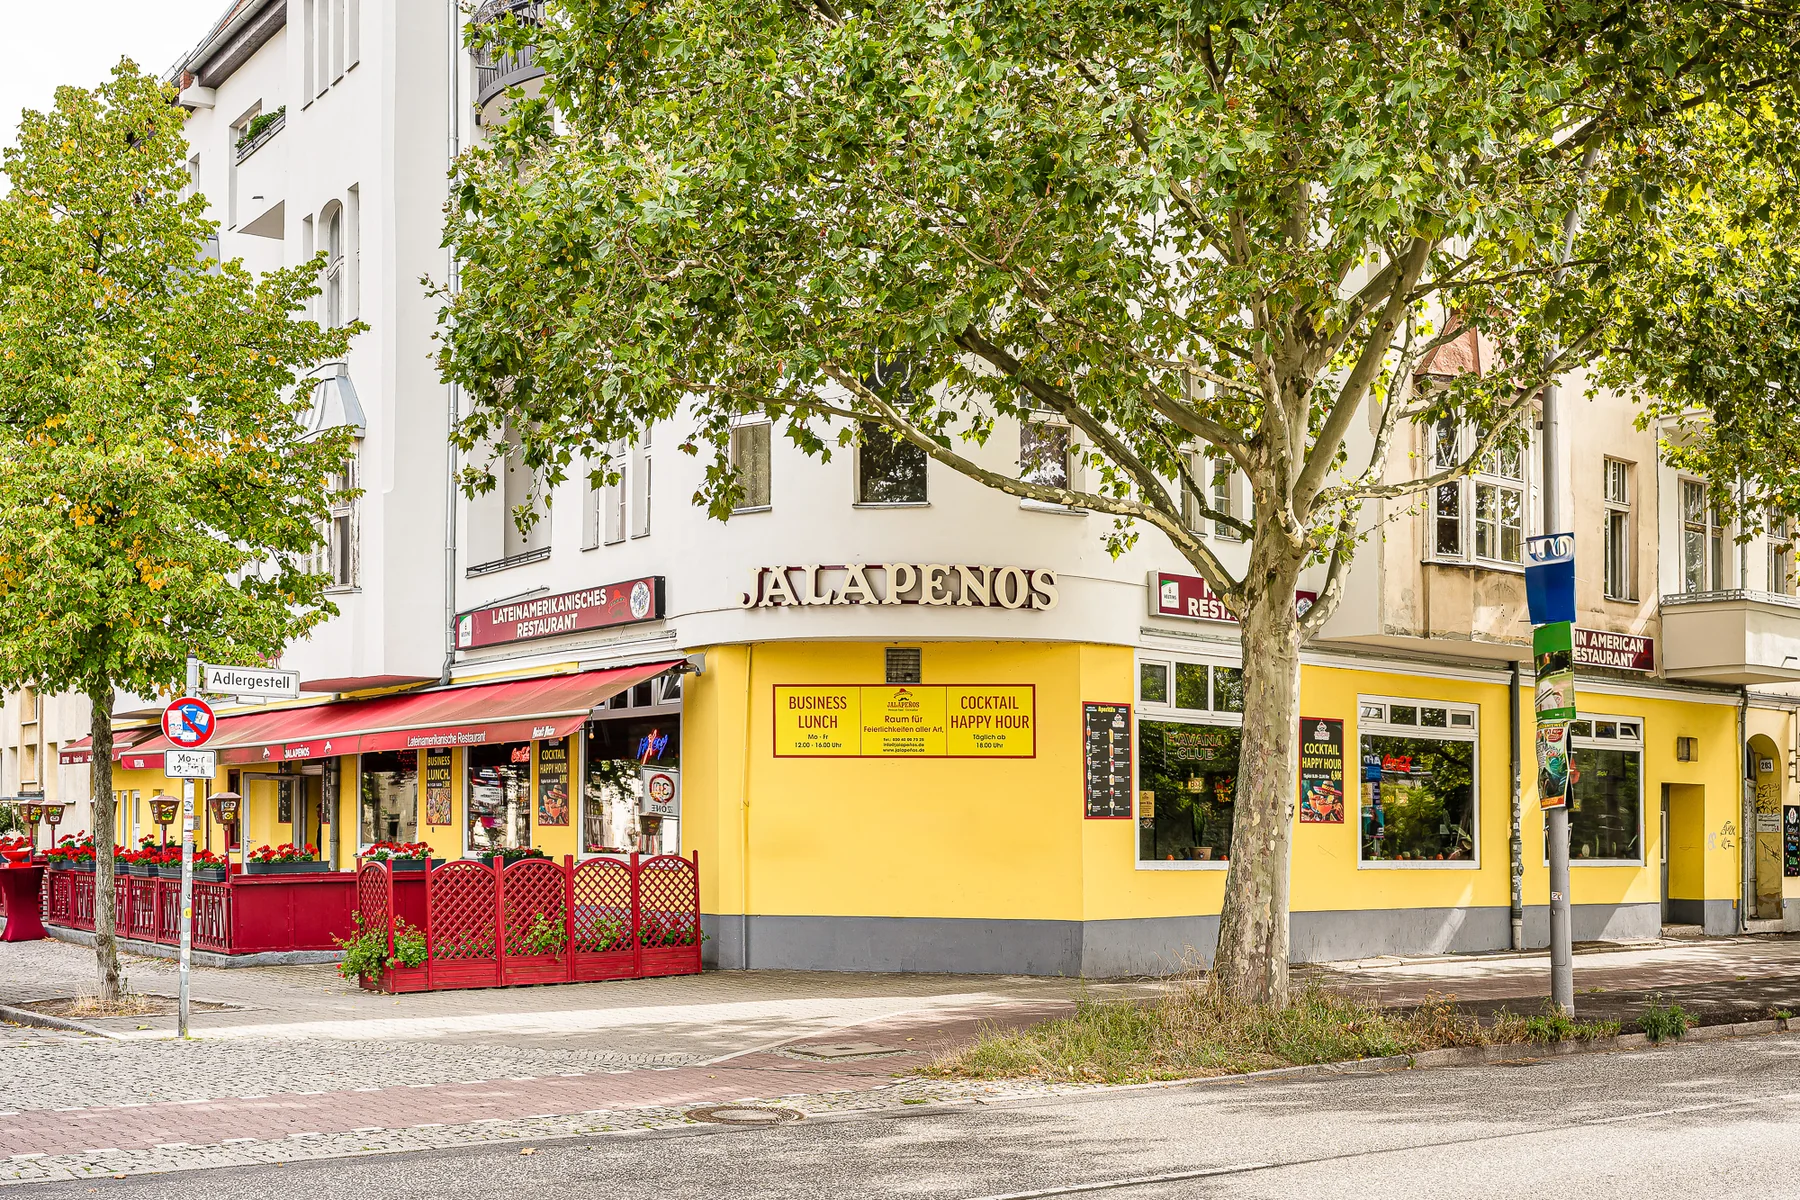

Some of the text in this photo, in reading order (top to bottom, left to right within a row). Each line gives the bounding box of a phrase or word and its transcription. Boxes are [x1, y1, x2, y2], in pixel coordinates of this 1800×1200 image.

[741, 563, 1060, 611] JALAPENOS
[492, 588, 607, 625] LATEINAMERIKANISCHES
[516, 613, 578, 638] RESTAURANT
[1590, 633, 1644, 653] AMERICAN
[212, 671, 290, 689] Adlergestell
[789, 696, 847, 710] BUSINESS
[960, 695, 1019, 710] COCKTAIL
[798, 715, 838, 729] LUNCH
[884, 715, 923, 723] Raum für
[951, 715, 1030, 729] HAPPY HOUR
[863, 725, 914, 733] Feierlichkeiten
[407, 731, 486, 747] Lateinamerikanische Restaurant
[1166, 732, 1225, 747] HAVANA
[541, 749, 566, 760] COCKTAIL
[1177, 747, 1215, 761] CLUB
[1304, 743, 1340, 755] COCKTAIL
[427, 756, 451, 766] BUSINESS
[1302, 757, 1342, 770] HAPPY HOUR
[540, 763, 567, 774] HAPPY HOUR
